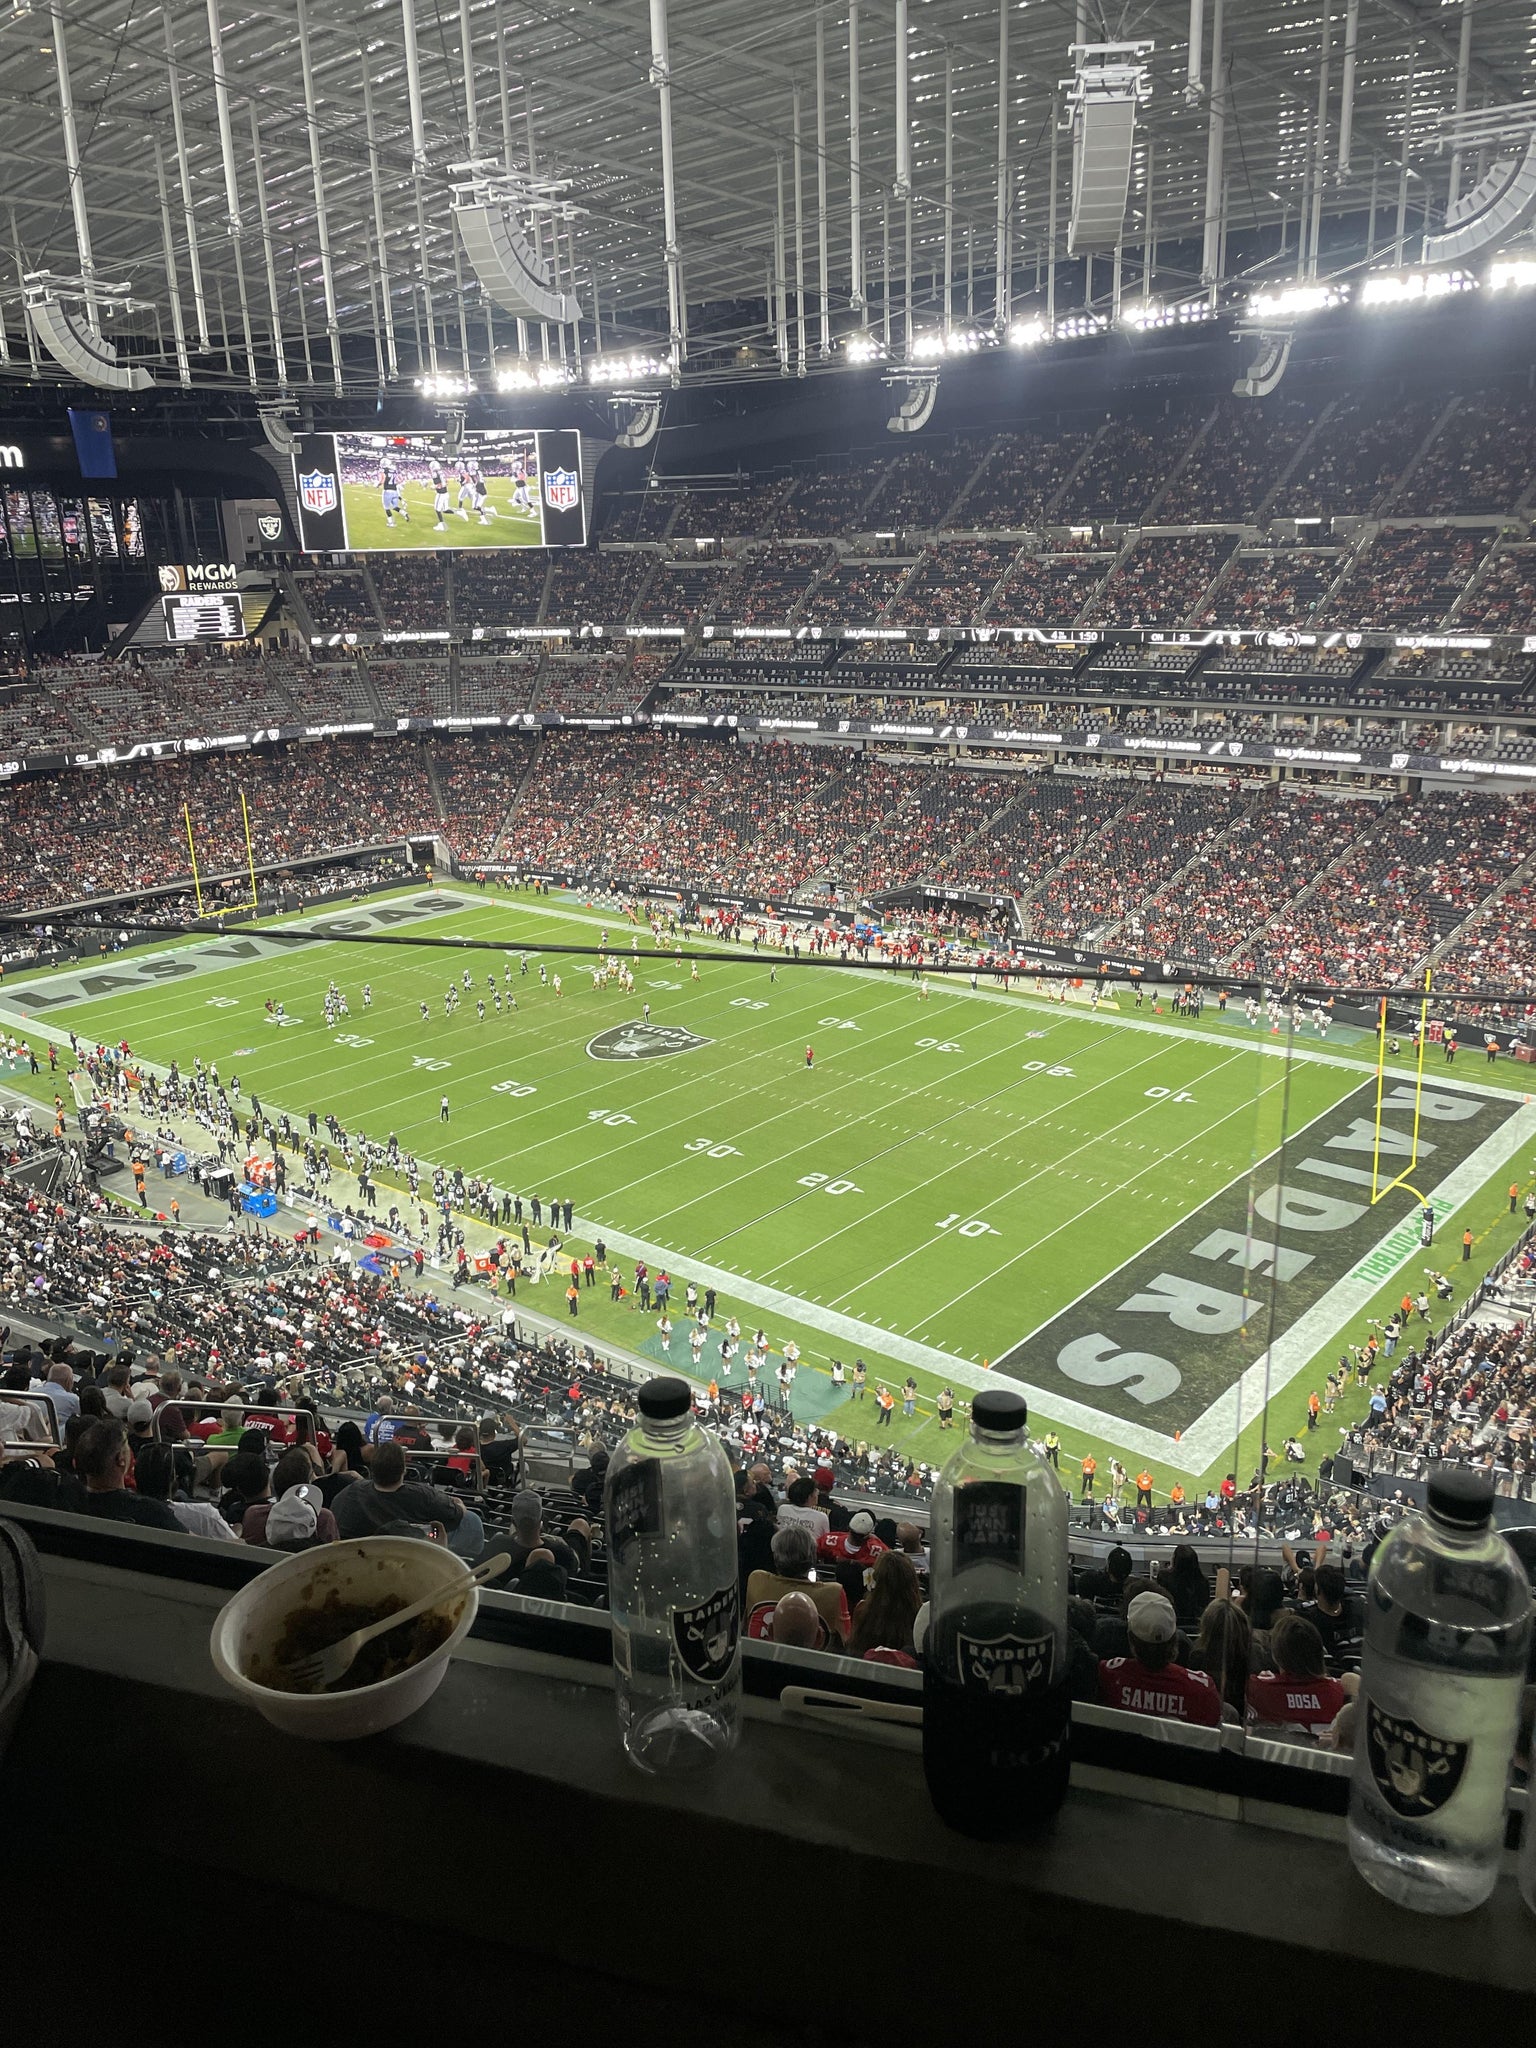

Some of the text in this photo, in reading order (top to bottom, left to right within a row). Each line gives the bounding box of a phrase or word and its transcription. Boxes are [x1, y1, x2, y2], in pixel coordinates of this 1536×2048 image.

[306, 489, 333, 505] NFL
[550, 487, 574, 503] NFL
[187, 564, 237, 581] MGM
[189, 581, 239, 591] REWARDS
[180, 595, 225, 607] RAIDERS
[1079, 632, 1098, 641] 1:50
[945, 891, 958, 900] 1:50
[1025, 945, 1038, 953] VEGAS
[1111, 961, 1126, 969] VEGAS
[8, 959, 197, 1008] LAS
[633, 1023, 703, 1044] RAIDERS
[914, 1037, 961, 1052] 30
[412, 1055, 453, 1072] 40
[1022, 1060, 1073, 1076] 20
[490, 1080, 538, 1097] 50
[1143, 1086, 1193, 1102] 10
[587, 1109, 632, 1127] 40
[683, 1138, 738, 1158] 30
[796, 1171, 858, 1196] 20
[934, 1213, 991, 1237] 10
[1056, 1086, 1486, 1405] RAIDERS
[1350, 1226, 1419, 1285] FOOTBALL
[1427, 1449, 1438, 1457] 15
[967, 1503, 1009, 1518] JUST
[968, 1517, 1007, 1531] WIN
[683, 1583, 738, 1625] RAIDER
[968, 1643, 1047, 1661] RAIDERS
[1121, 1686, 1188, 1716] SAMUEL
[1286, 1693, 1322, 1710] BOSA
[1372, 1707, 1458, 1755] RAIDERS
